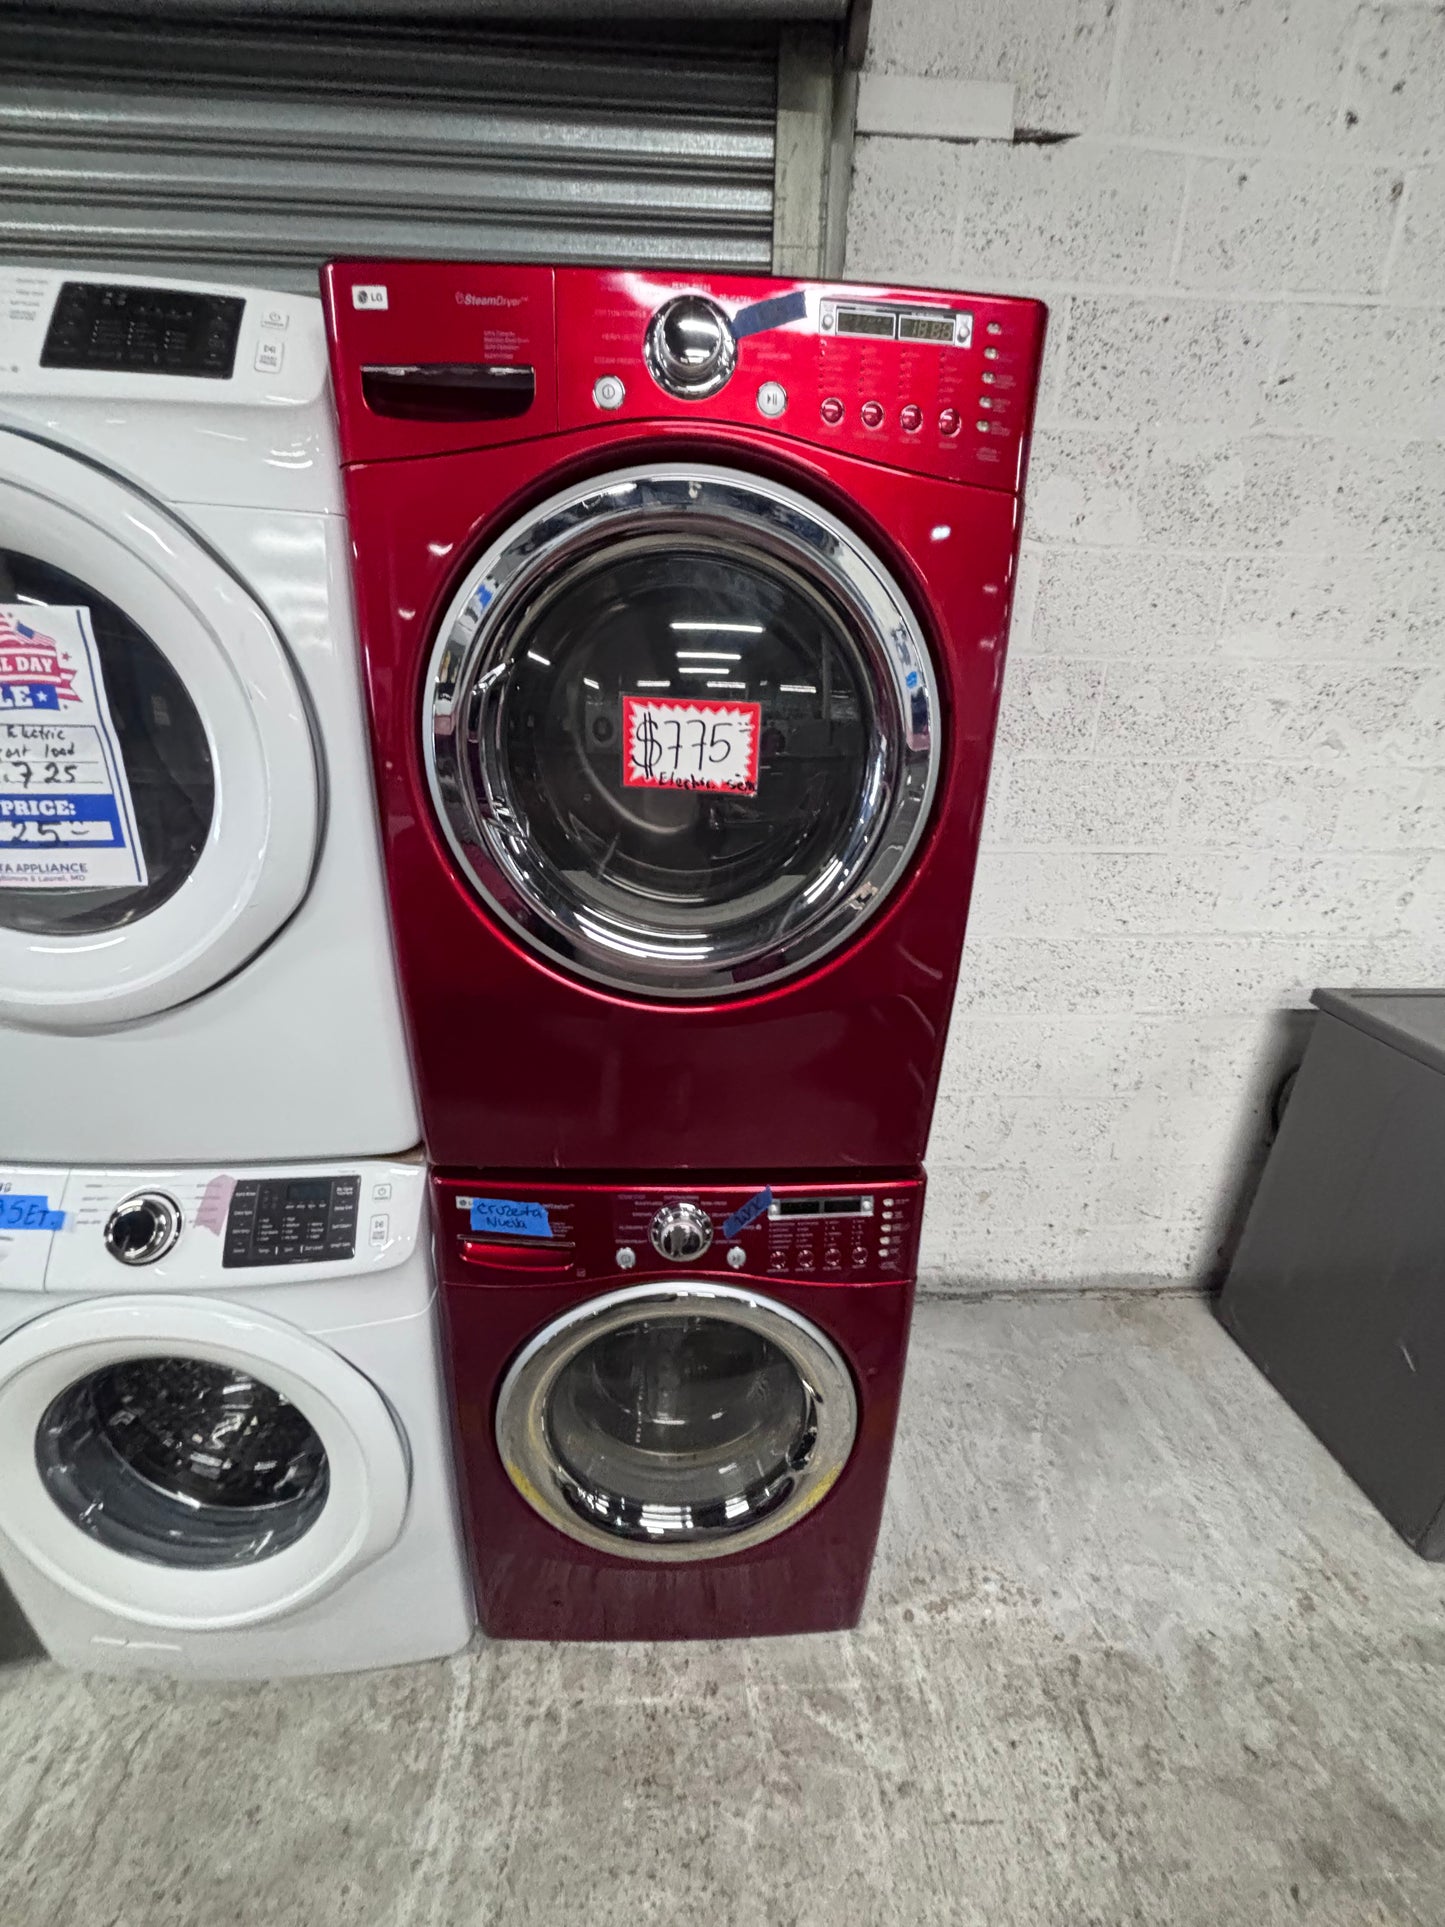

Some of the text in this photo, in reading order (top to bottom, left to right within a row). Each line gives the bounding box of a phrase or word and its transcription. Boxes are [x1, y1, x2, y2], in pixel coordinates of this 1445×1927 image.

[15, 657, 53, 673] DAY
[0, 685, 34, 708] LE
[45, 742, 75, 758] load
[632, 711, 733, 780] $775
[1, 799, 77, 816] PRICE:
[0, 863, 88, 873] A APPLIANCE
